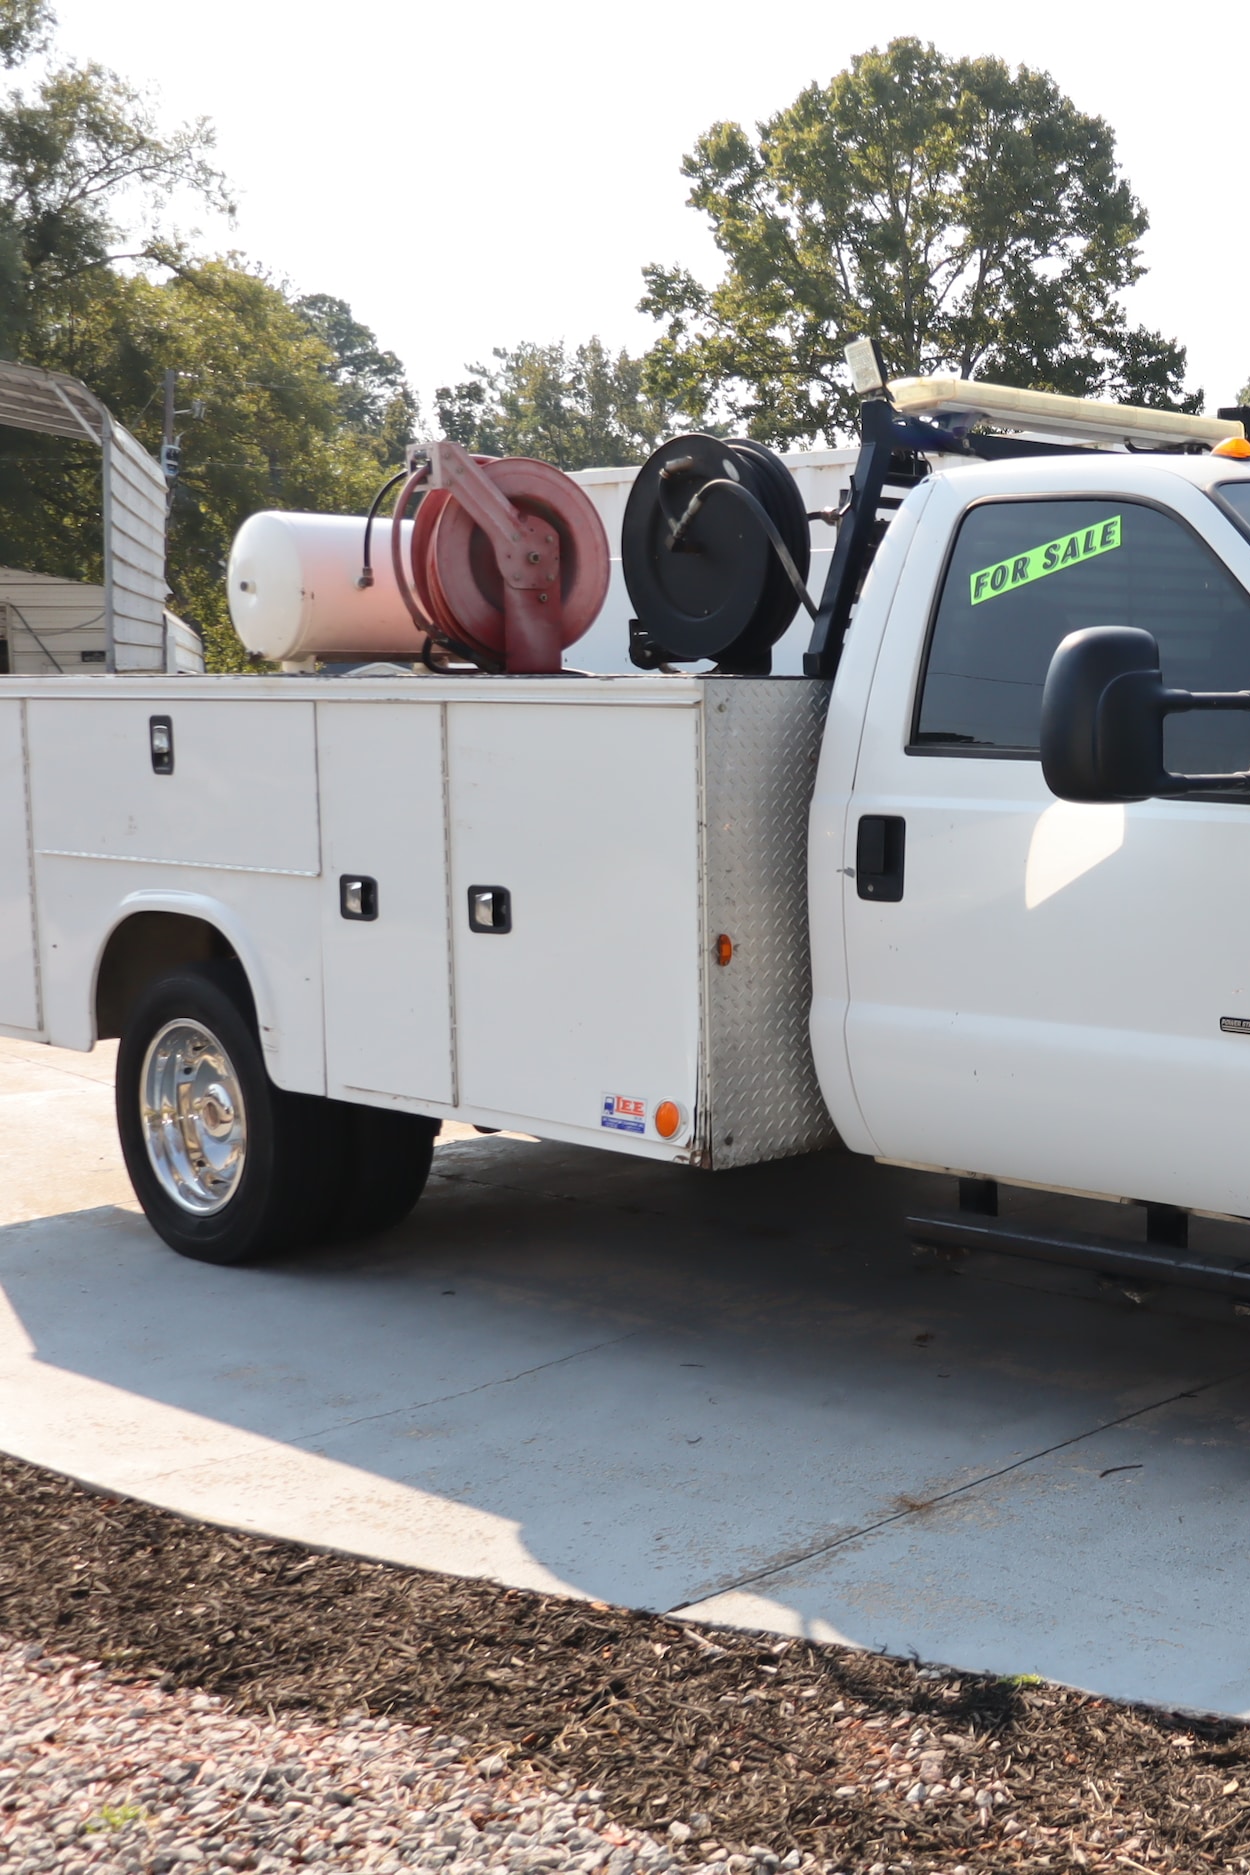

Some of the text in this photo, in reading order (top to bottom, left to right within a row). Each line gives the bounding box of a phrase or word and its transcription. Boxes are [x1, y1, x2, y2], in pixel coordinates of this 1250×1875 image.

[973, 520, 1118, 600] FOR SALE
[615, 1095, 645, 1117] LEE
